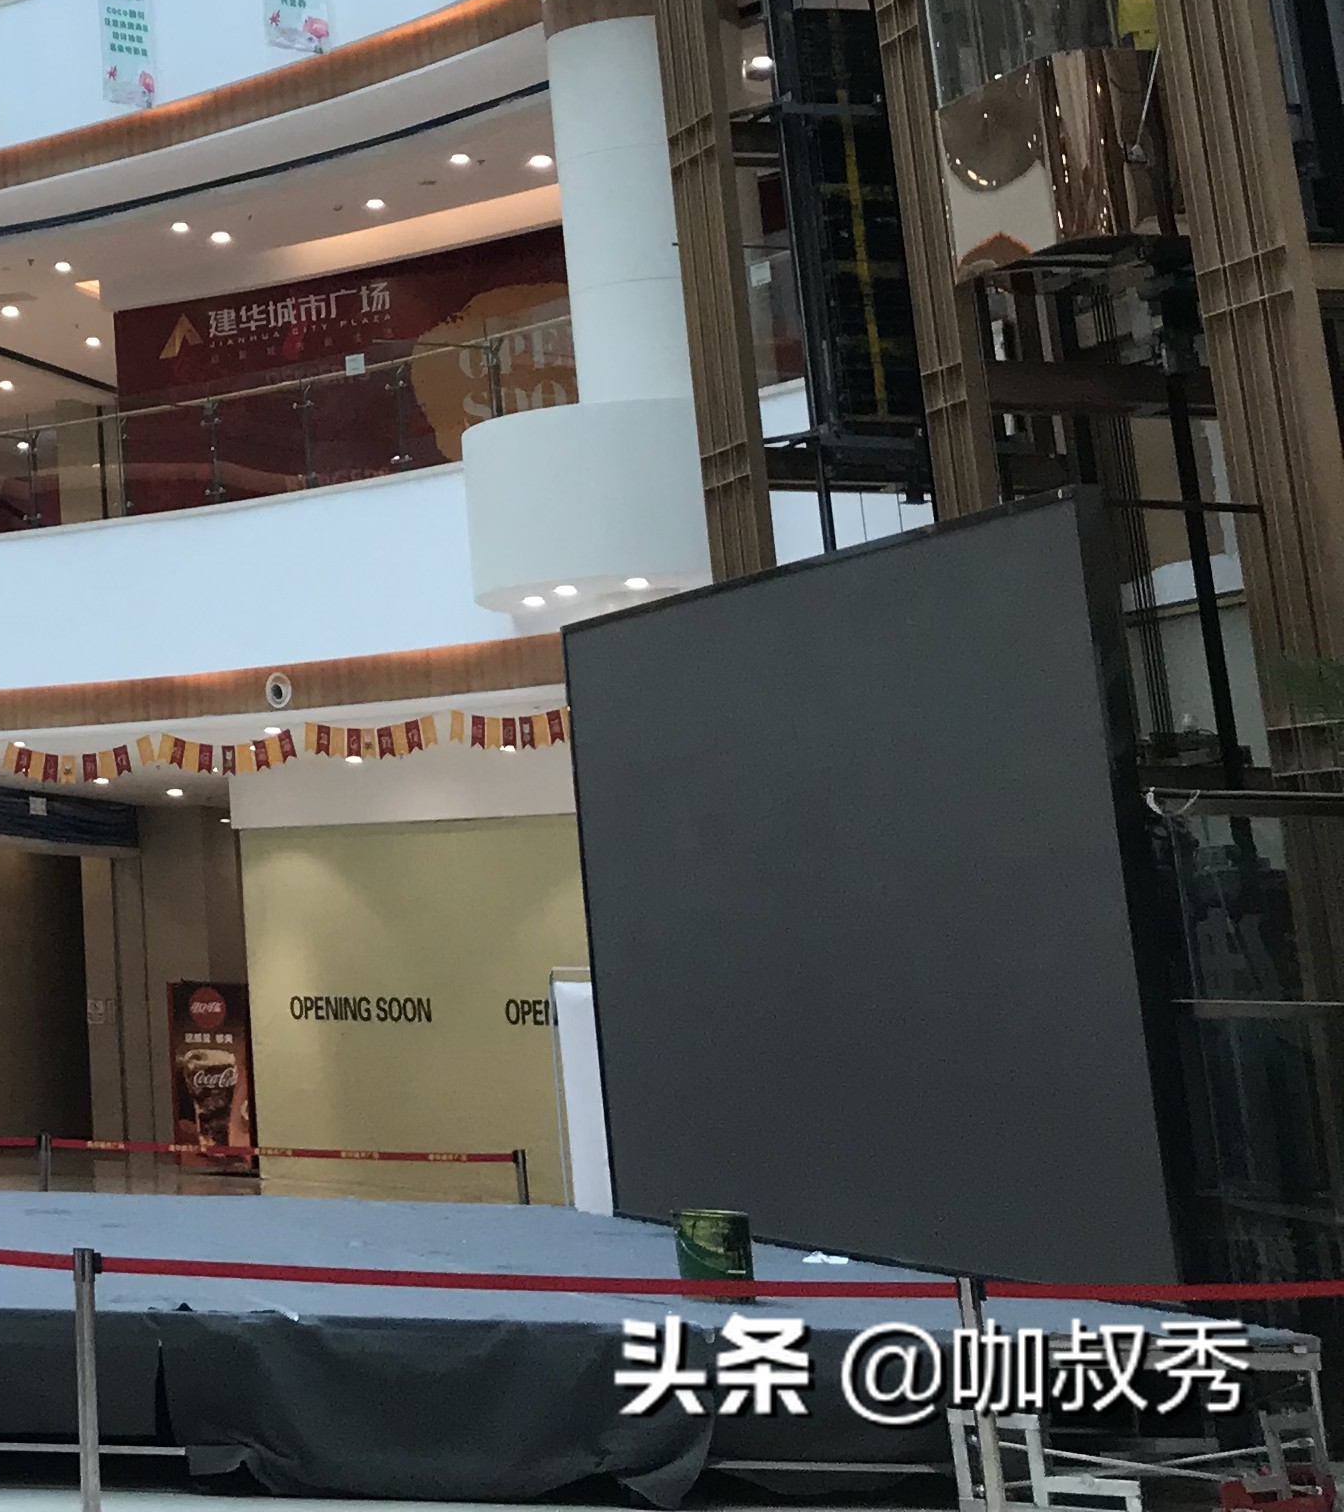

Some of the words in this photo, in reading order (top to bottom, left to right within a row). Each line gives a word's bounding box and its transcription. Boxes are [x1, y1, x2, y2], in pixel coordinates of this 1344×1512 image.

[208, 281, 391, 338] 建华城市广场
[210, 331, 280, 348] JIANHUA
[291, 323, 328, 336] CITY
[340, 314, 391, 327] PLAZA
[290, 996, 372, 1022] OPENING
[376, 997, 432, 1023] SOON
